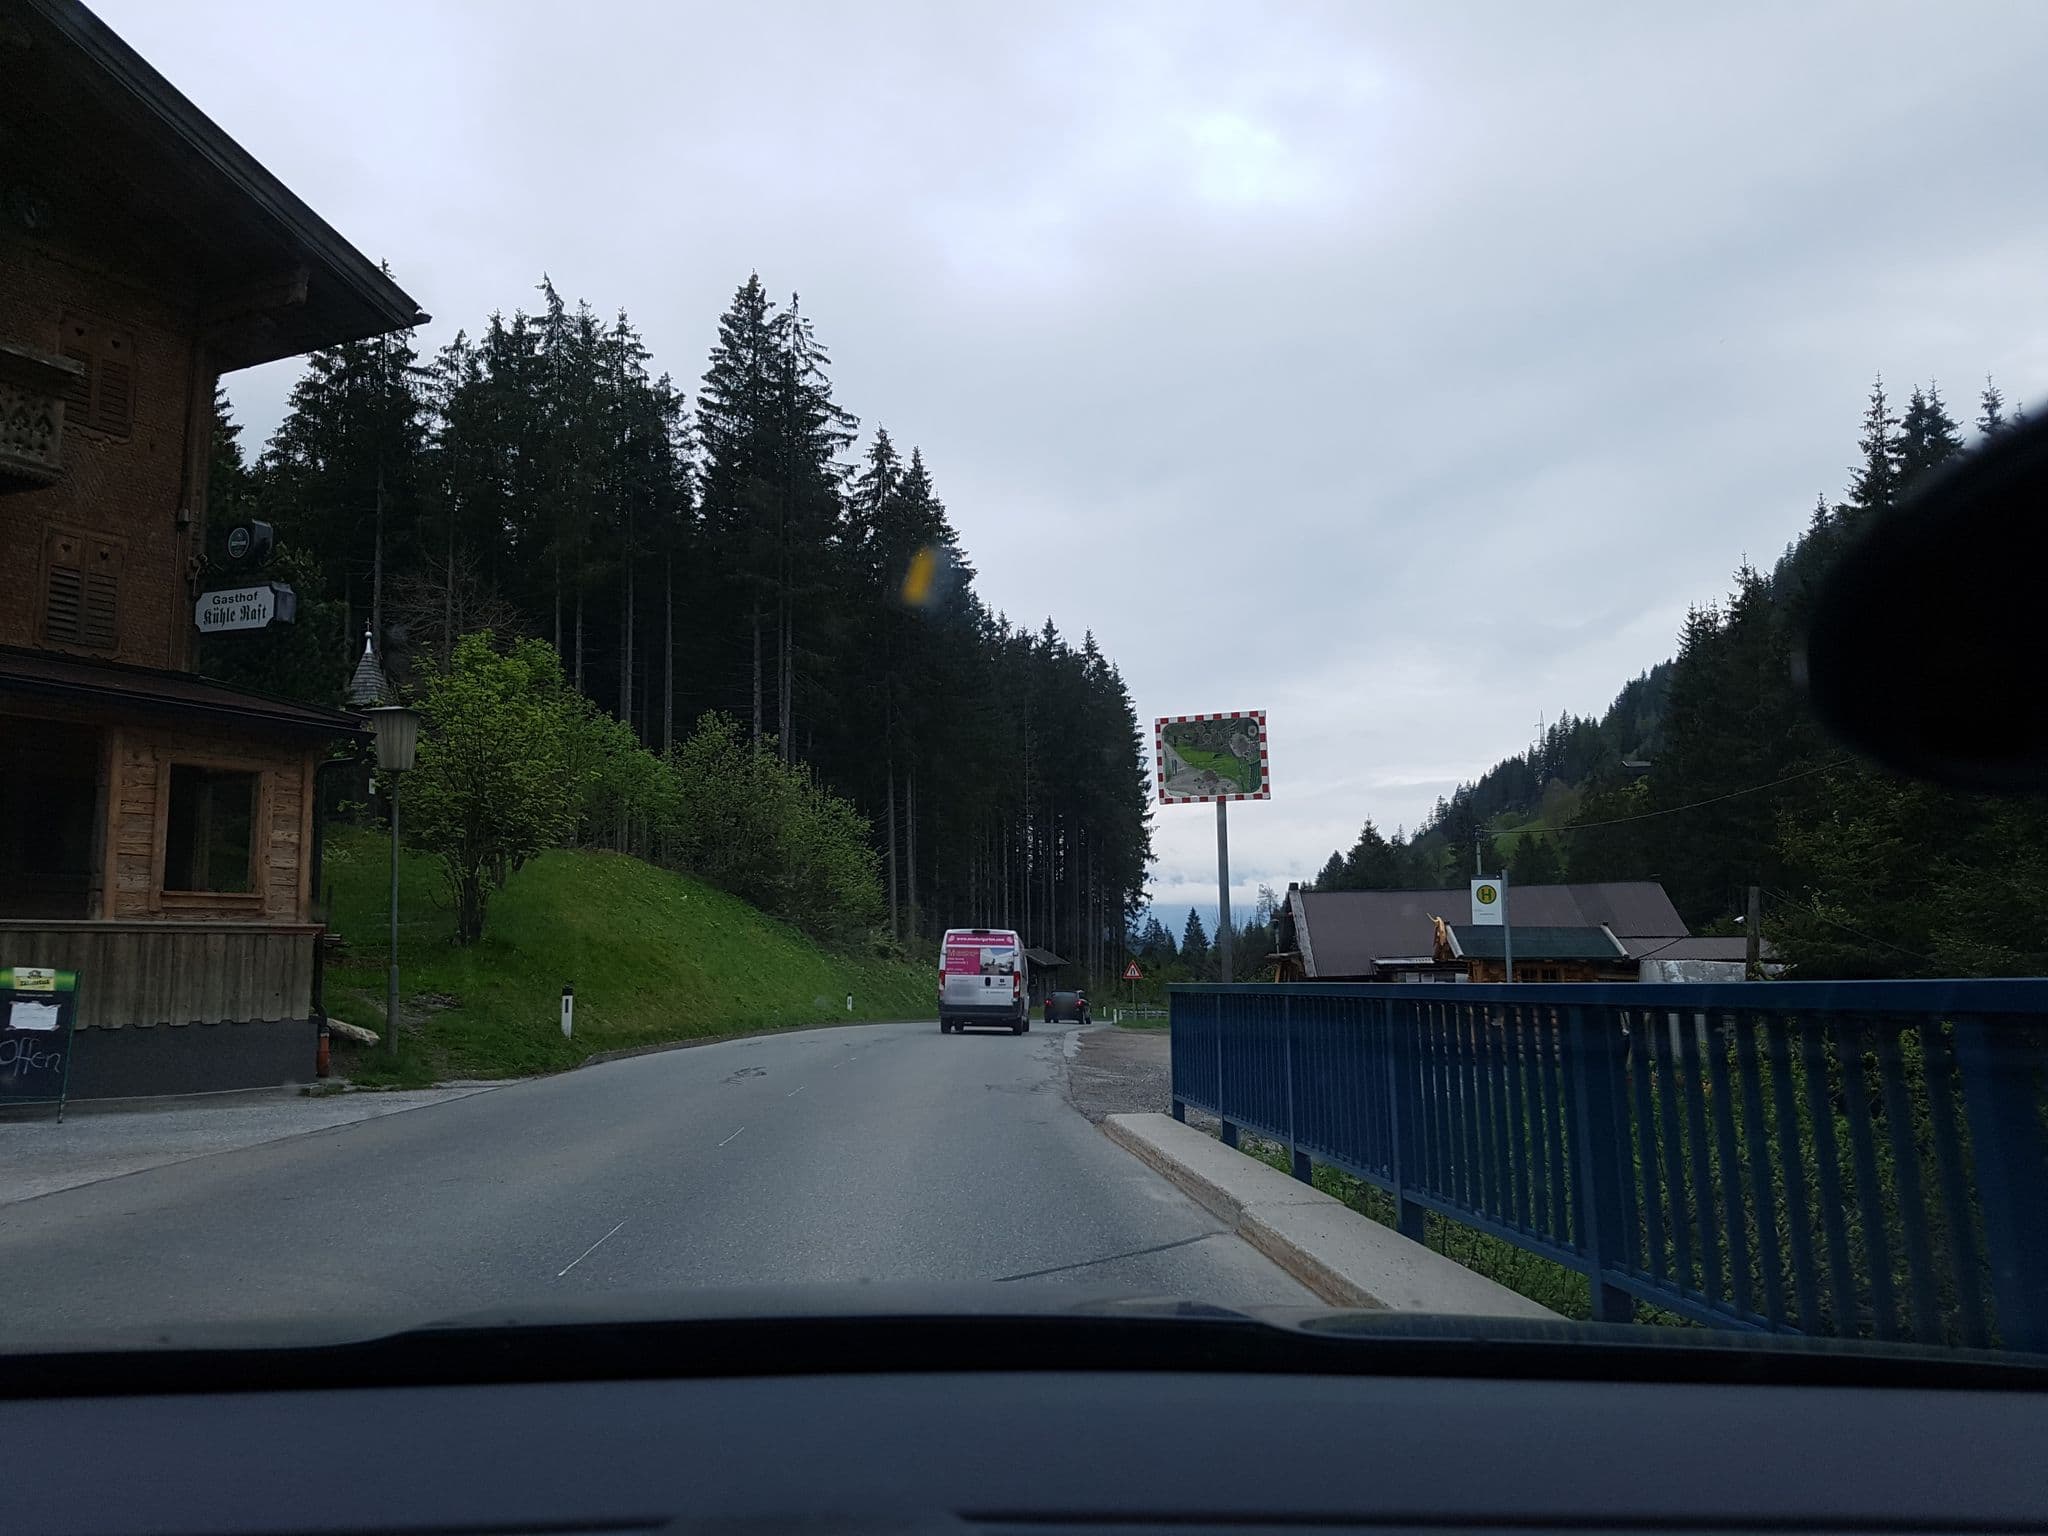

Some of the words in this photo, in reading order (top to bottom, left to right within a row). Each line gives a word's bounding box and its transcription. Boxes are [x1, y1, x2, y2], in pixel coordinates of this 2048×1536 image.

[212, 591, 258, 605] Gasthof
[203, 606, 236, 627] Kühle
[0, 1037, 60, 1076] Offen
